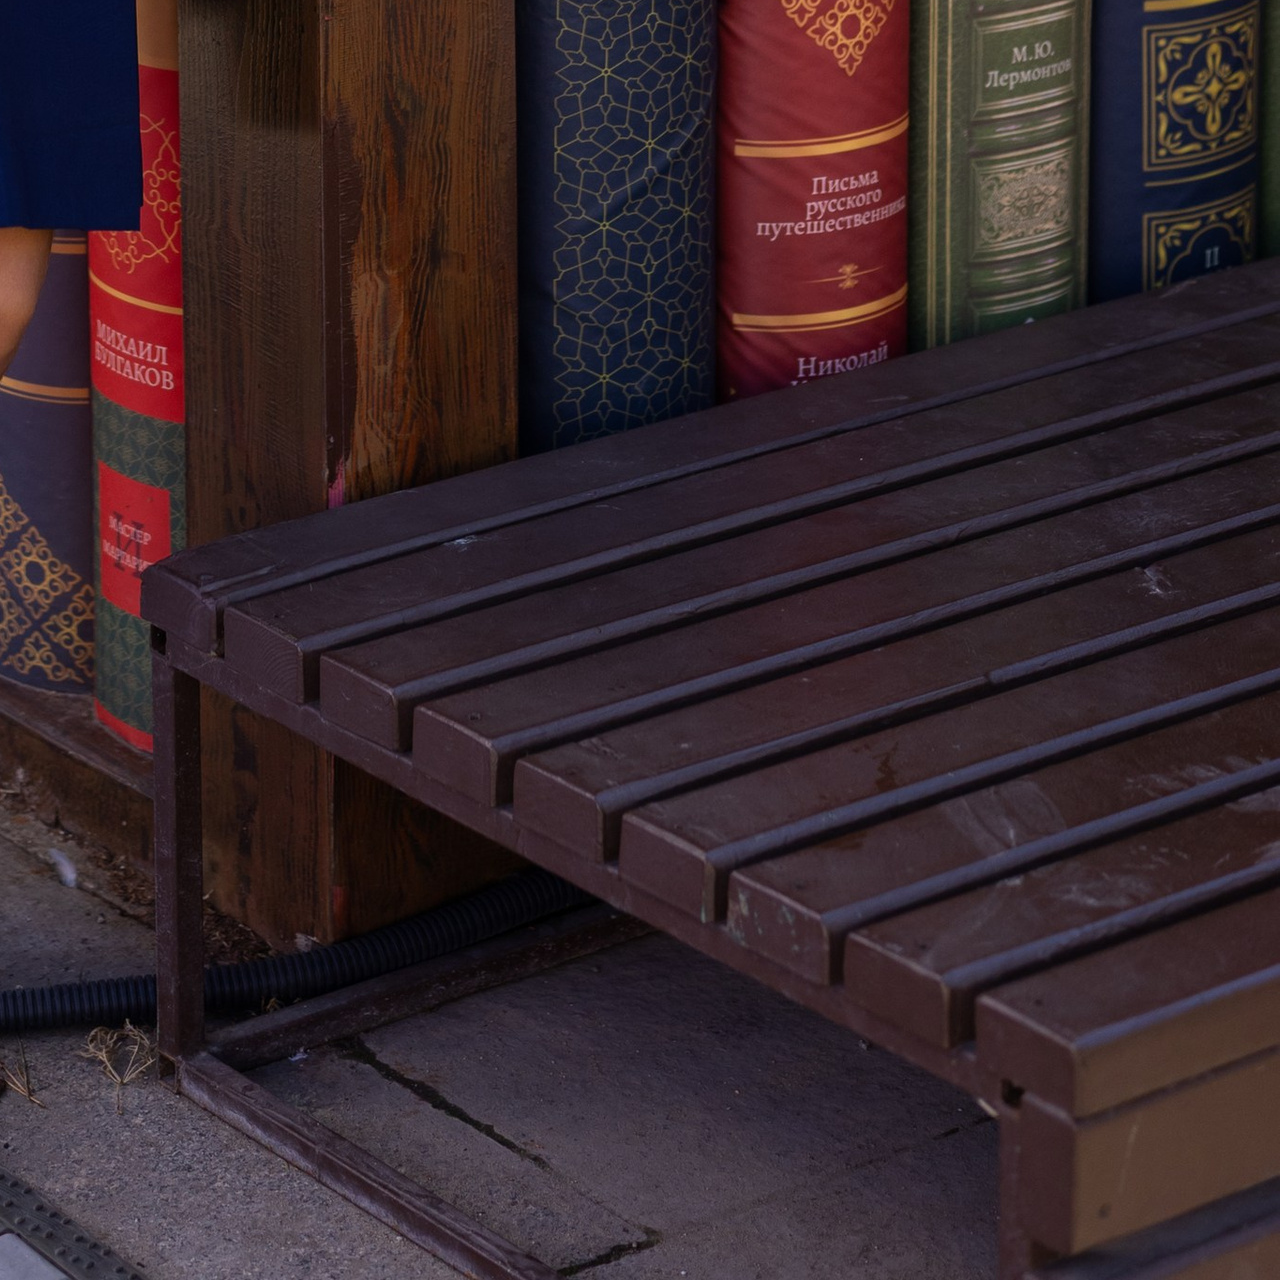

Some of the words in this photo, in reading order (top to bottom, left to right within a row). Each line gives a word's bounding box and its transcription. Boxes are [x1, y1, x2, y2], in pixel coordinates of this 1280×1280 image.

[1011, 40, 1055, 64] М.Ю.
[985, 58, 1072, 90] Лермонтов
[811, 170, 879, 196] Письма
[756, 195, 906, 242] путешественника
[805, 188, 882, 221] русского
[96, 319, 168, 365] МИХАИЛ
[95, 340, 174, 390] БУЛГАКОВ
[797, 340, 888, 378] Николай
[108, 515, 152, 546] МАСТЕР
[102, 539, 155, 572] МАРГАРИ
